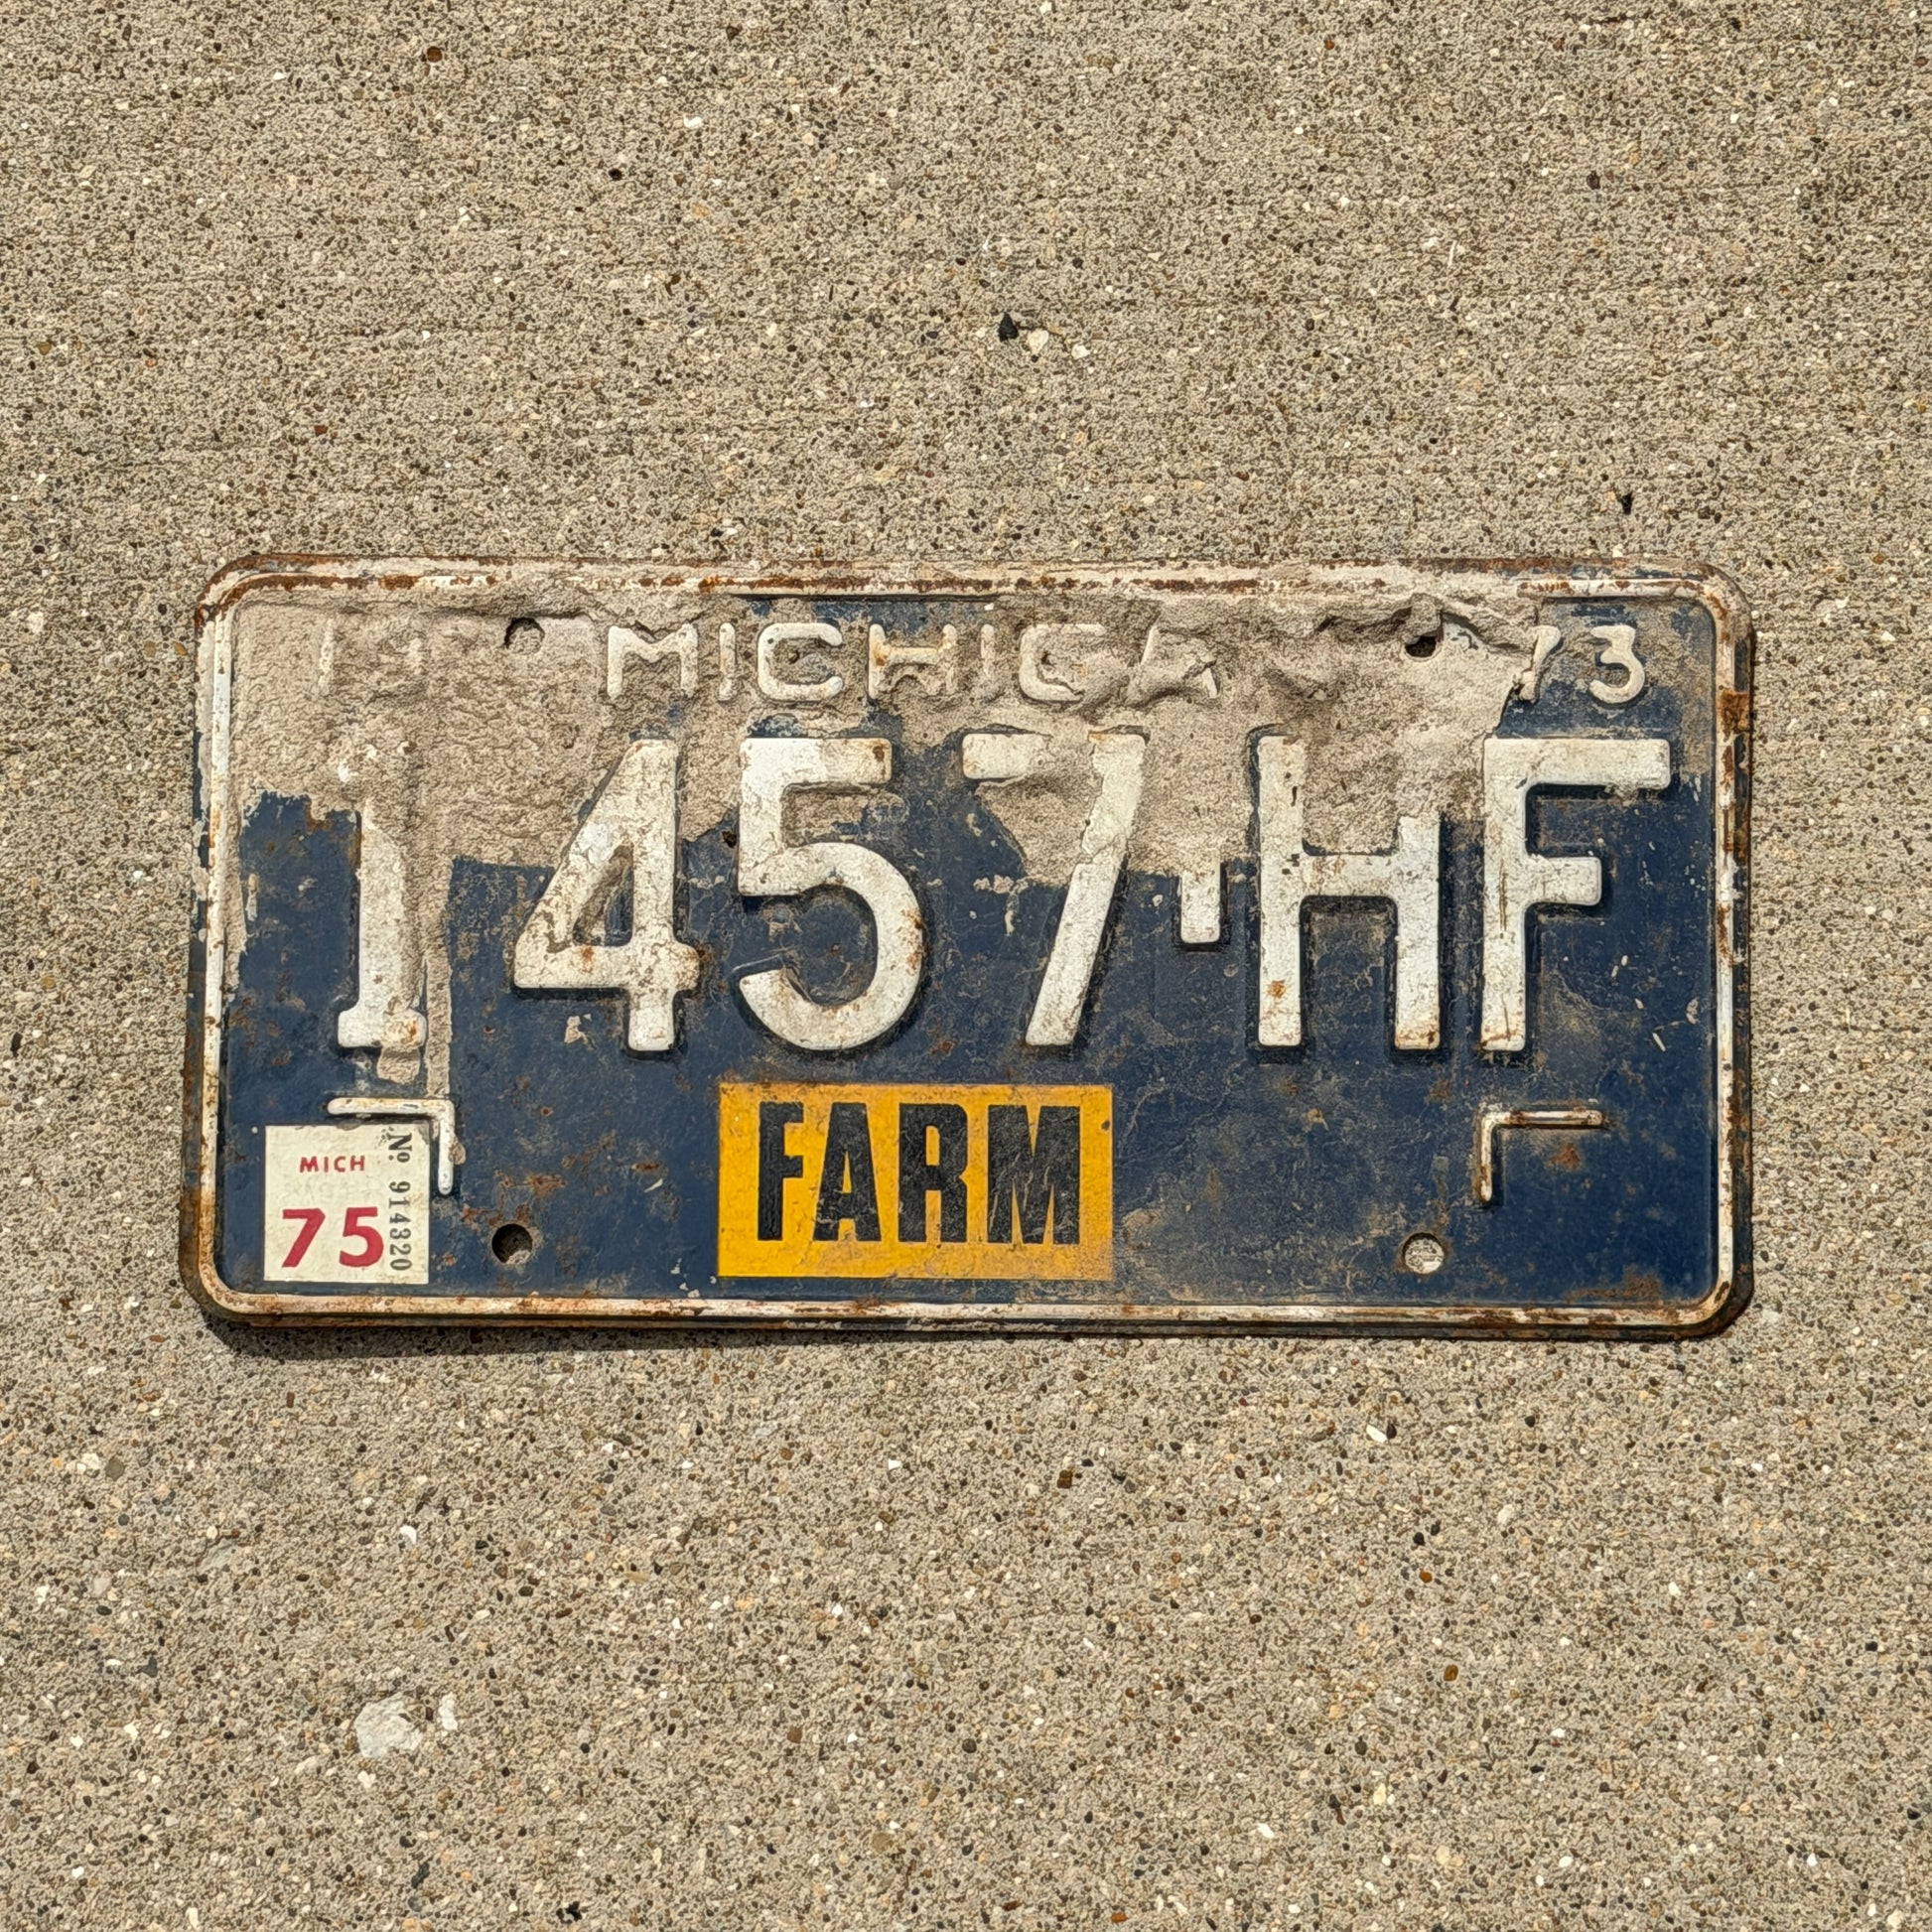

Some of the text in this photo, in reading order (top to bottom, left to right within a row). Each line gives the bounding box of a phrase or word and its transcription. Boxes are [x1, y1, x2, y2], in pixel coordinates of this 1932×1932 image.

[299, 1155, 366, 1173] MICH
[757, 1101, 1082, 1246] FARM
[280, 1205, 385, 1269] 75
[388, 1179, 413, 1272] 914320
